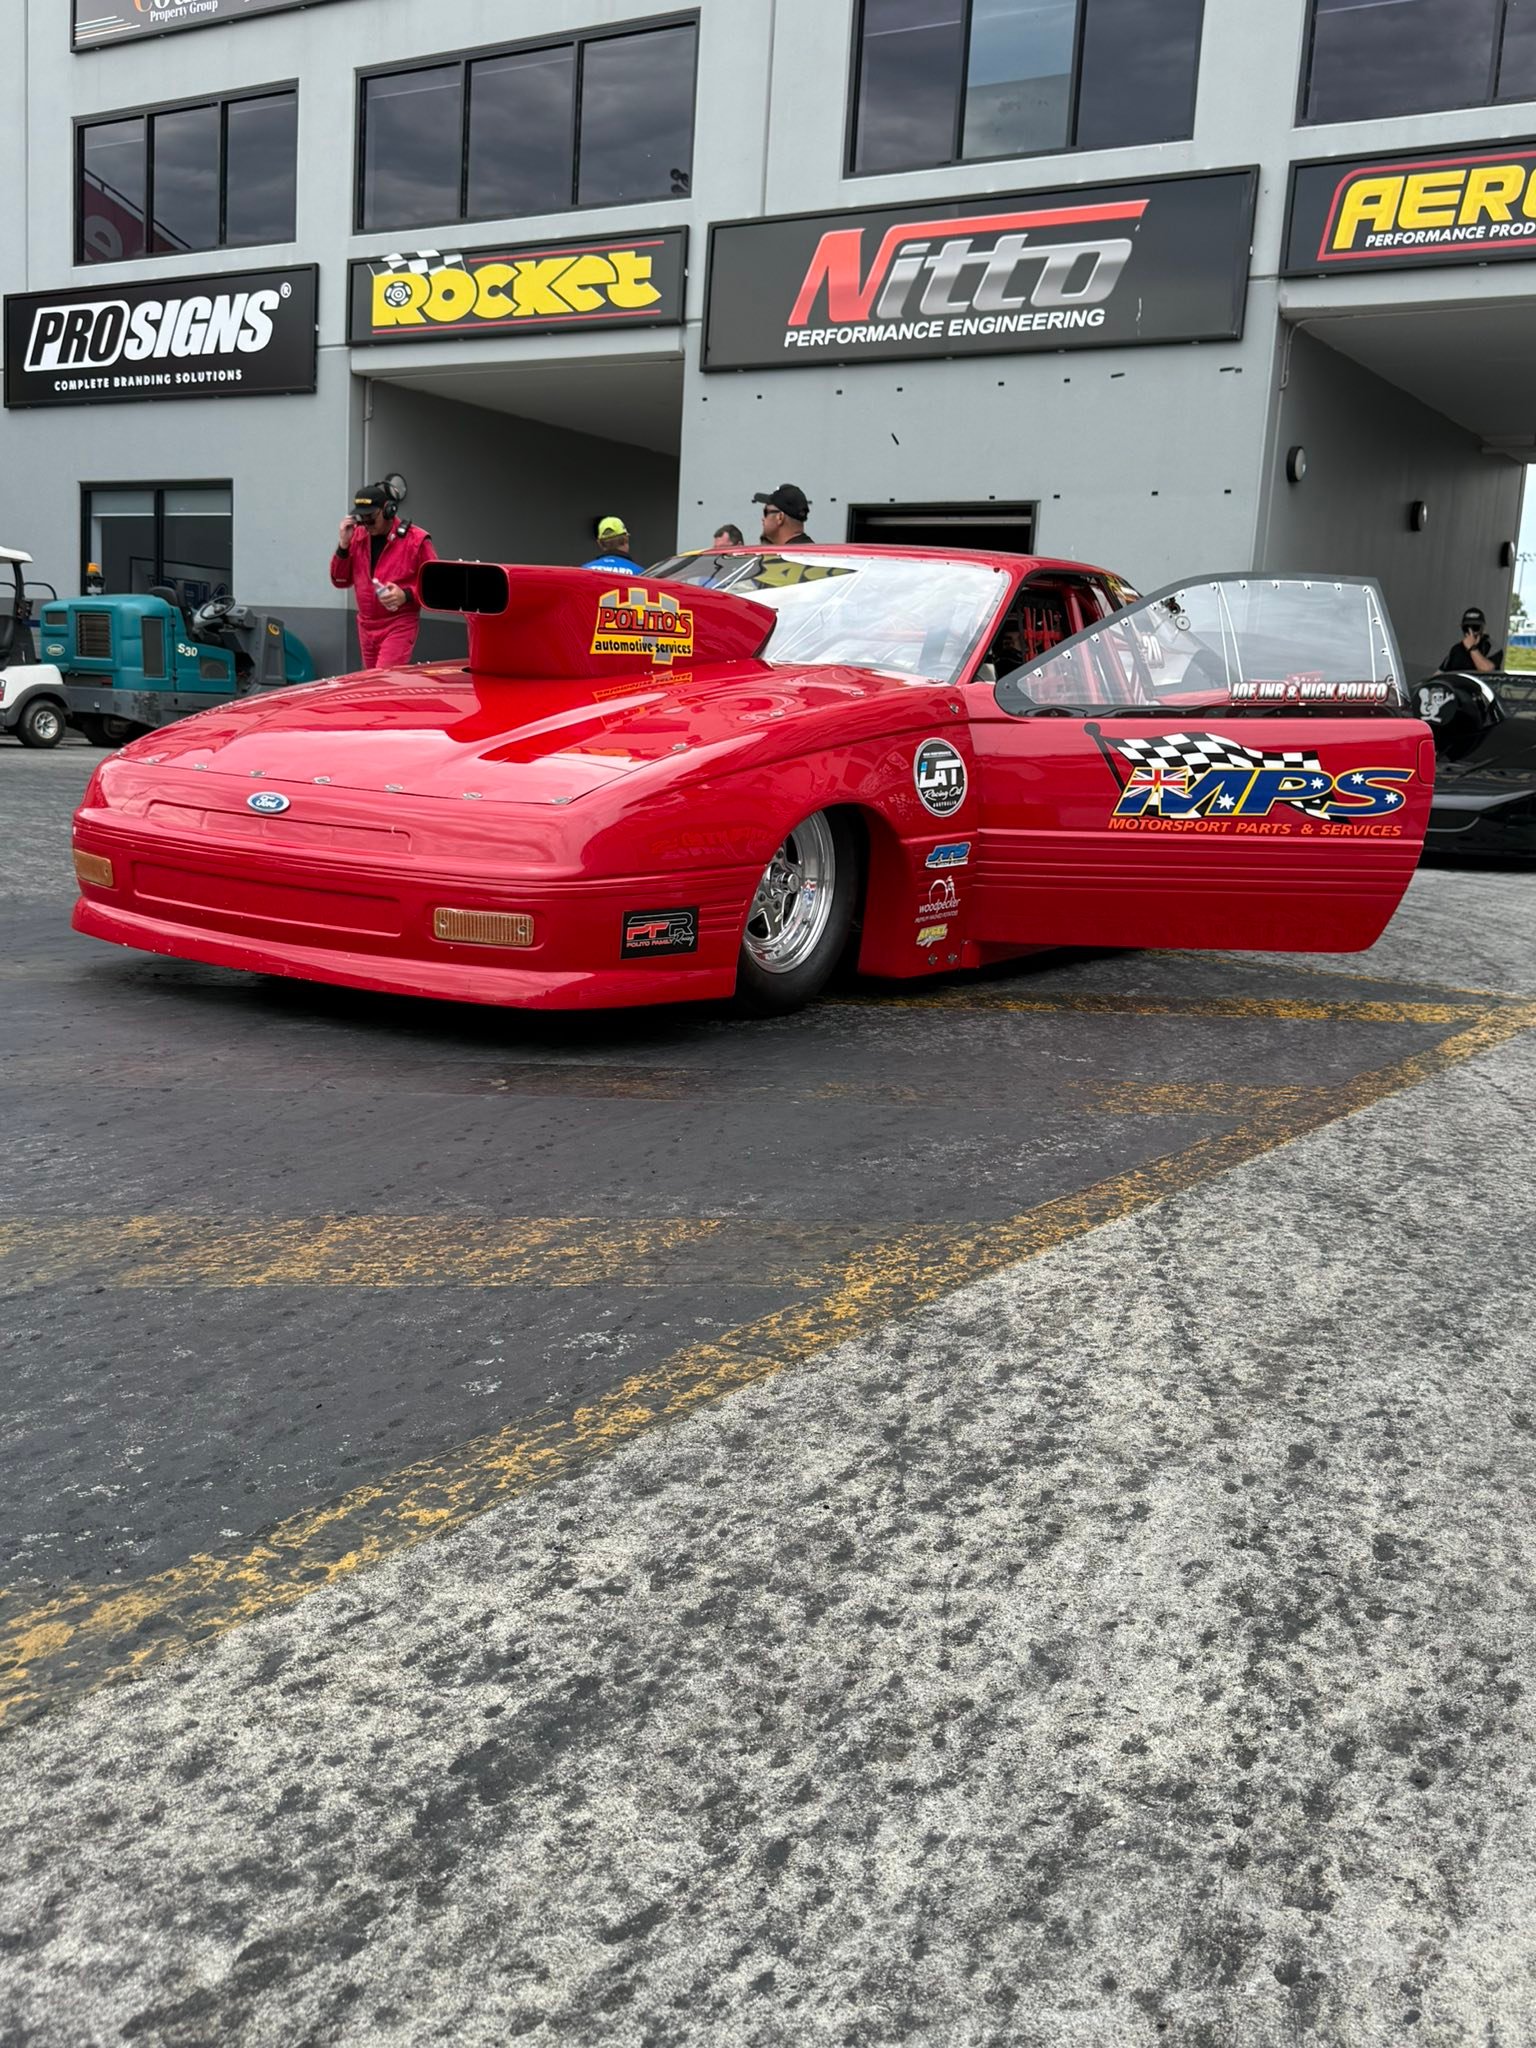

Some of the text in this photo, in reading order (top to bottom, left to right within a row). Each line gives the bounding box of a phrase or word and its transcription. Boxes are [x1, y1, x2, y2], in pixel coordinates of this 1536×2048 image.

[150, 6, 187, 22] Property
[189, 0, 219, 14] Group
[1333, 164, 1536, 250] AER
[1365, 225, 1486, 248] PERFORMANCE
[787, 199, 1150, 326] Nitto
[784, 308, 1106, 347] PERFORMANCE ENGINEERING
[54, 369, 243, 391] COMPLETE BRANDING SOLUTIONS
[597, 606, 692, 639] POLITO'S
[177, 643, 198, 657] S30
[595, 639, 692, 654] automotive services
[1300, 682, 1337, 699] NICK
[1337, 682, 1388, 699] POLITO
[919, 759, 961, 789] LAT
[1113, 767, 1416, 817] MPS
[1107, 818, 1403, 838] MOTORSPORT PARTS & SERVICES
[919, 897, 961, 914] woodpecker
[626, 940, 651, 948] POLITO
